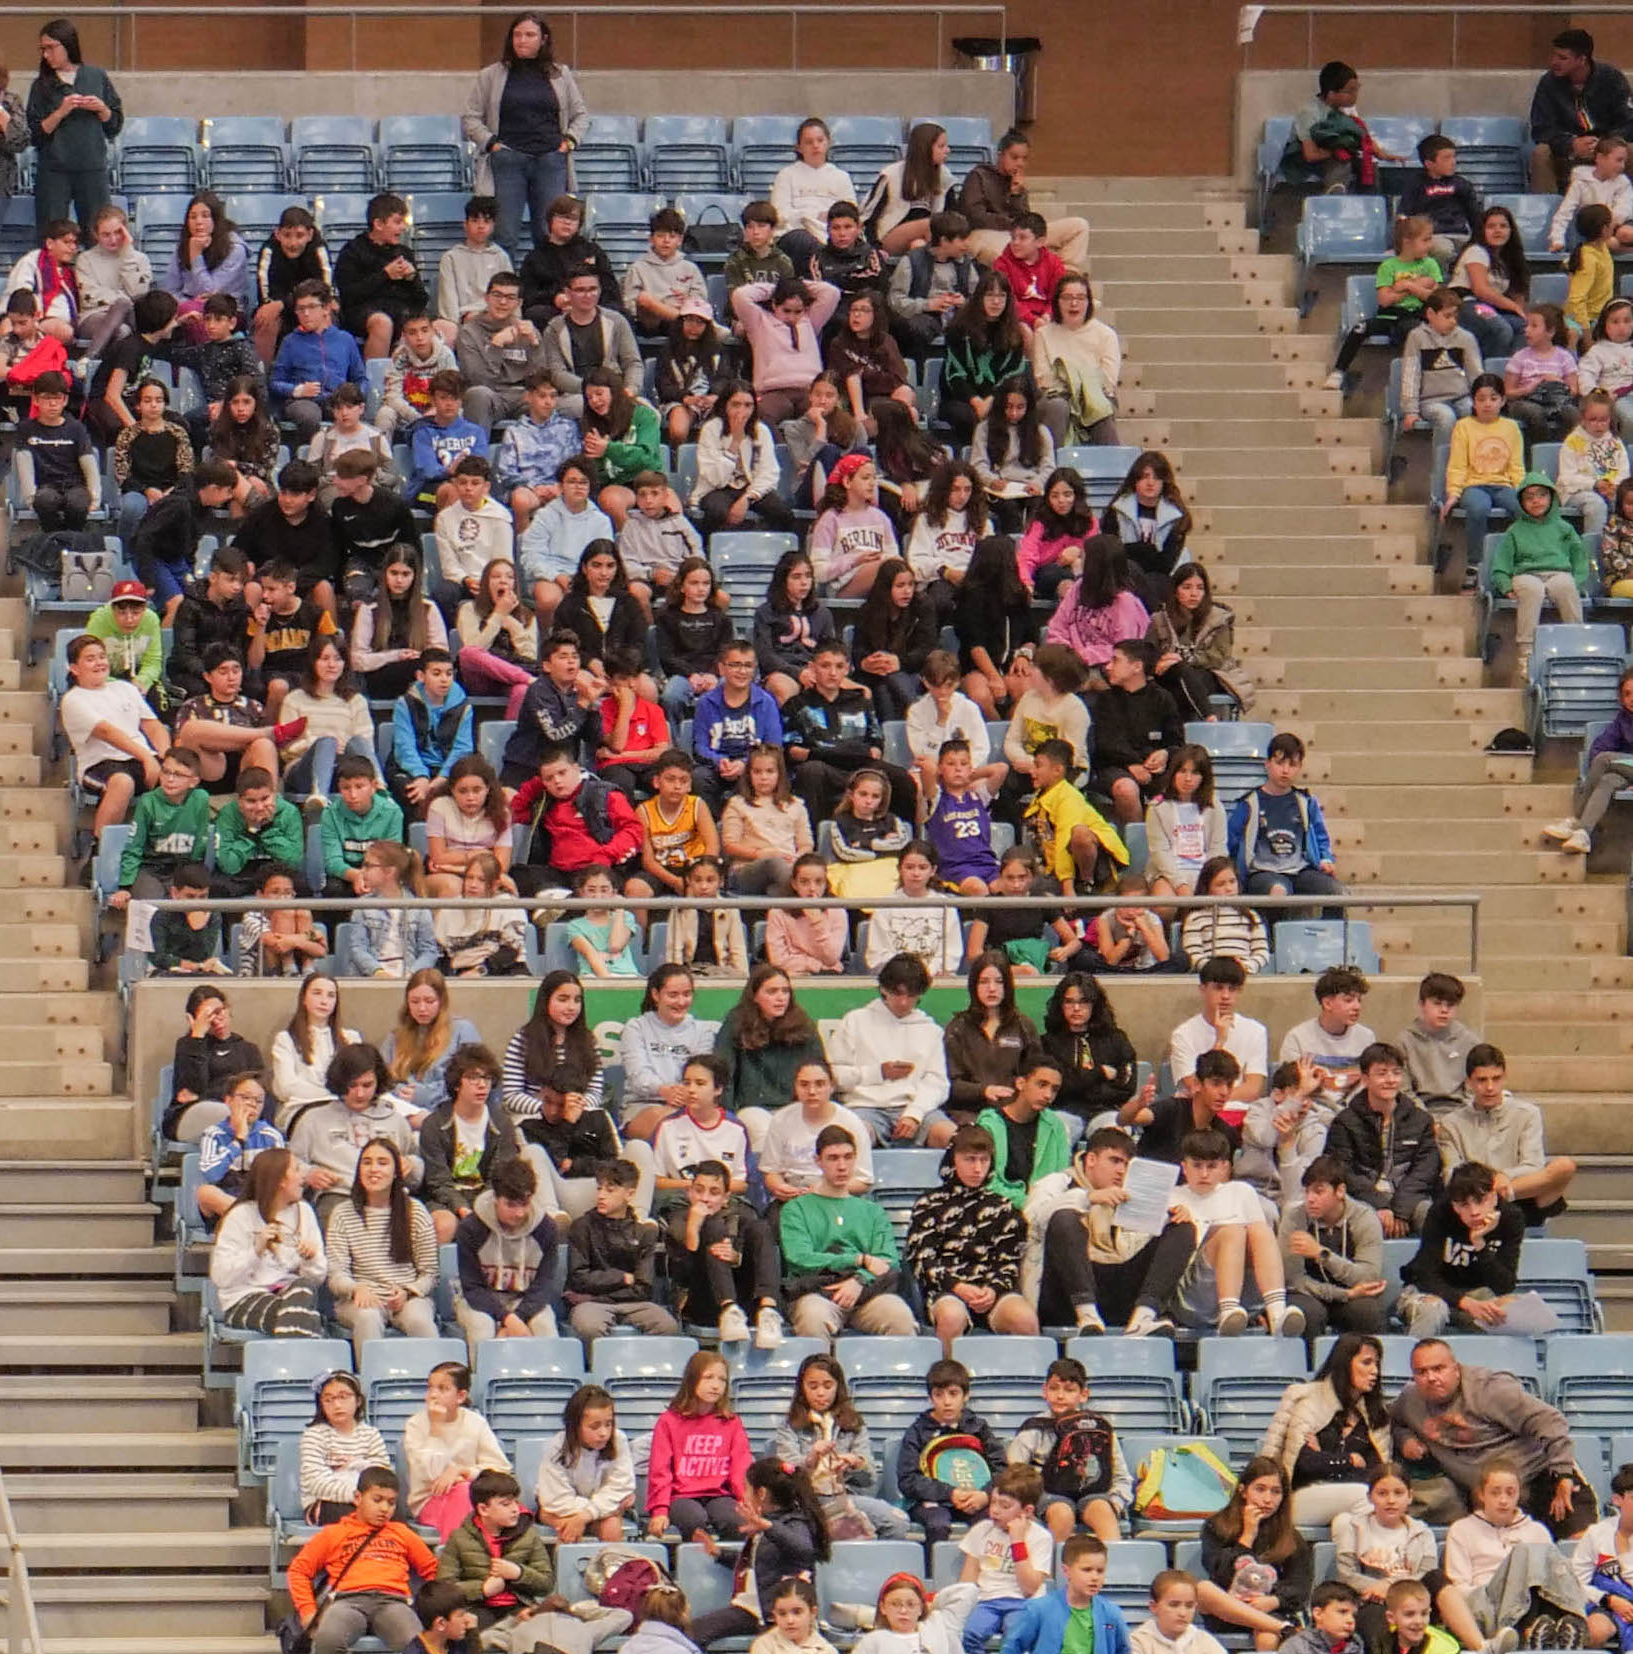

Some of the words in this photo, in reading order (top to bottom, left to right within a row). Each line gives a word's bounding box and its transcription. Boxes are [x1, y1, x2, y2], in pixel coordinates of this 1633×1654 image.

[840, 531, 884, 554] BERLIN
[954, 820, 981, 839] 23
[686, 1434, 724, 1455] KEEP
[676, 1455, 731, 1477] ACTIVE
